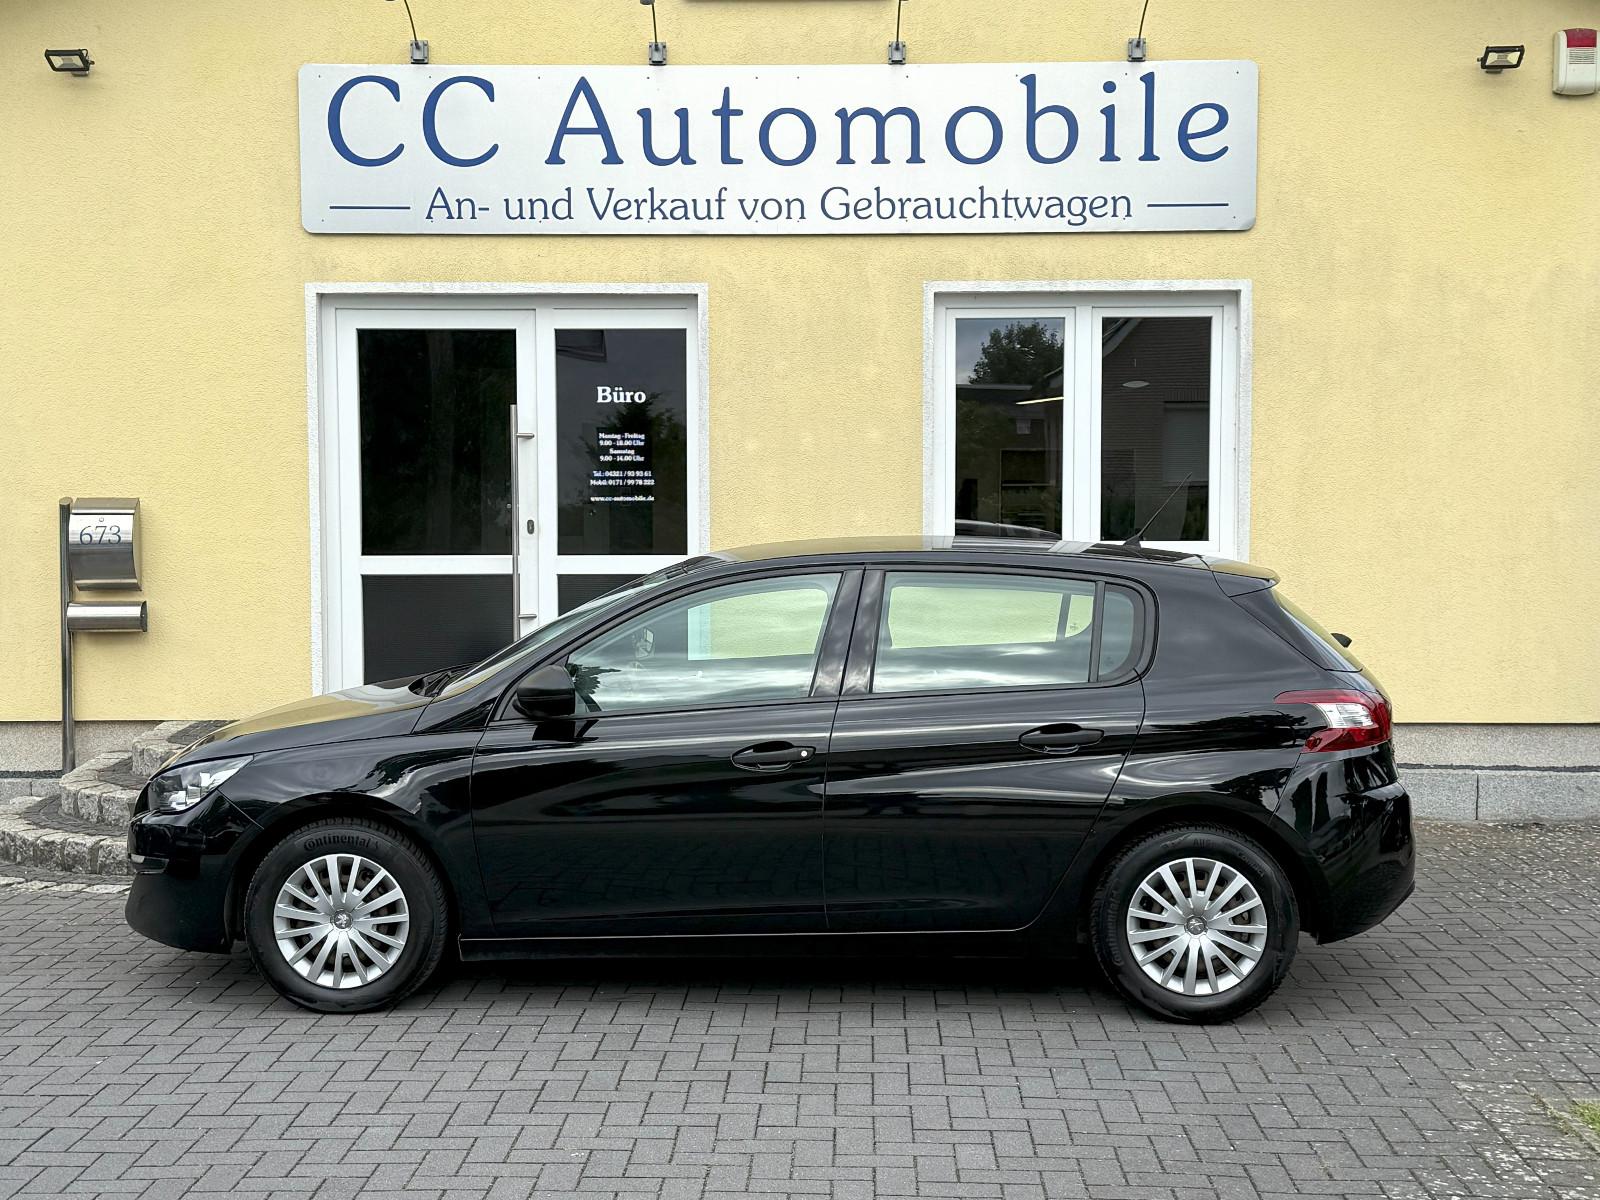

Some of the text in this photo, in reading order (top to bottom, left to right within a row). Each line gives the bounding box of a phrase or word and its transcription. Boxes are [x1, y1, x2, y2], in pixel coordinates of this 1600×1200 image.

[328, 72, 1228, 167] CC Automobile
[426, 187, 1132, 226] An- und Verkauf von Gebrauchtwagen
[597, 386, 647, 403] Büro
[79, 525, 122, 545] 673
[303, 833, 371, 852] Continental
